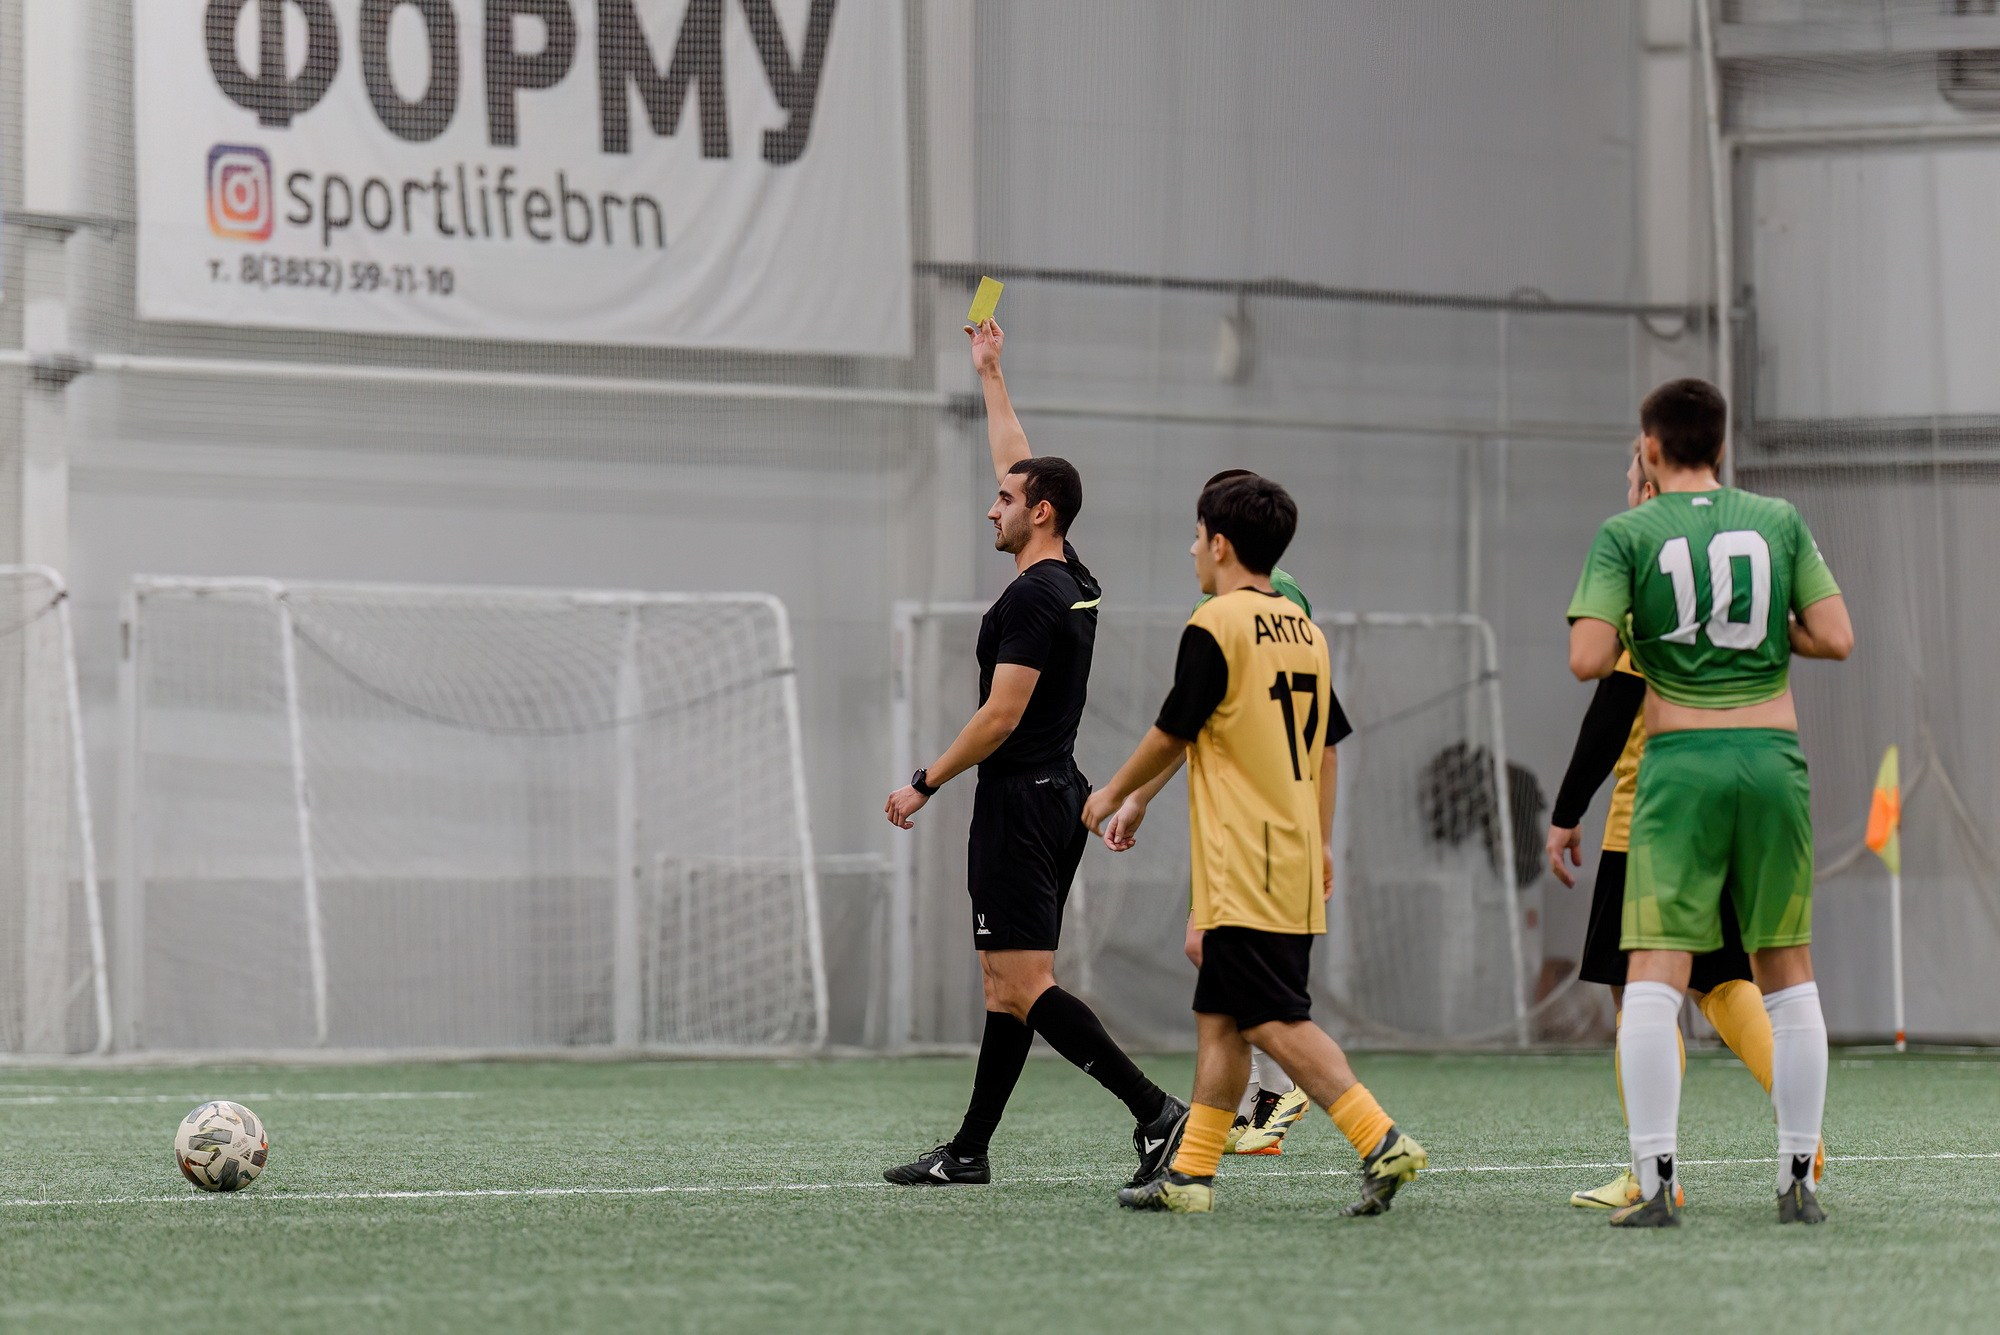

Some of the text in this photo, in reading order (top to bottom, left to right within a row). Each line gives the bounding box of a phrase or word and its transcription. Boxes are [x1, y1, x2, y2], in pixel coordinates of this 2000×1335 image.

[204, 0, 838, 165] ФОРМУ
[285, 164, 666, 248] sportlifebrn
[240, 255, 342, 294] 8(3852)
[1657, 529, 1771, 651] 10
[1268, 670, 1319, 782] 17
